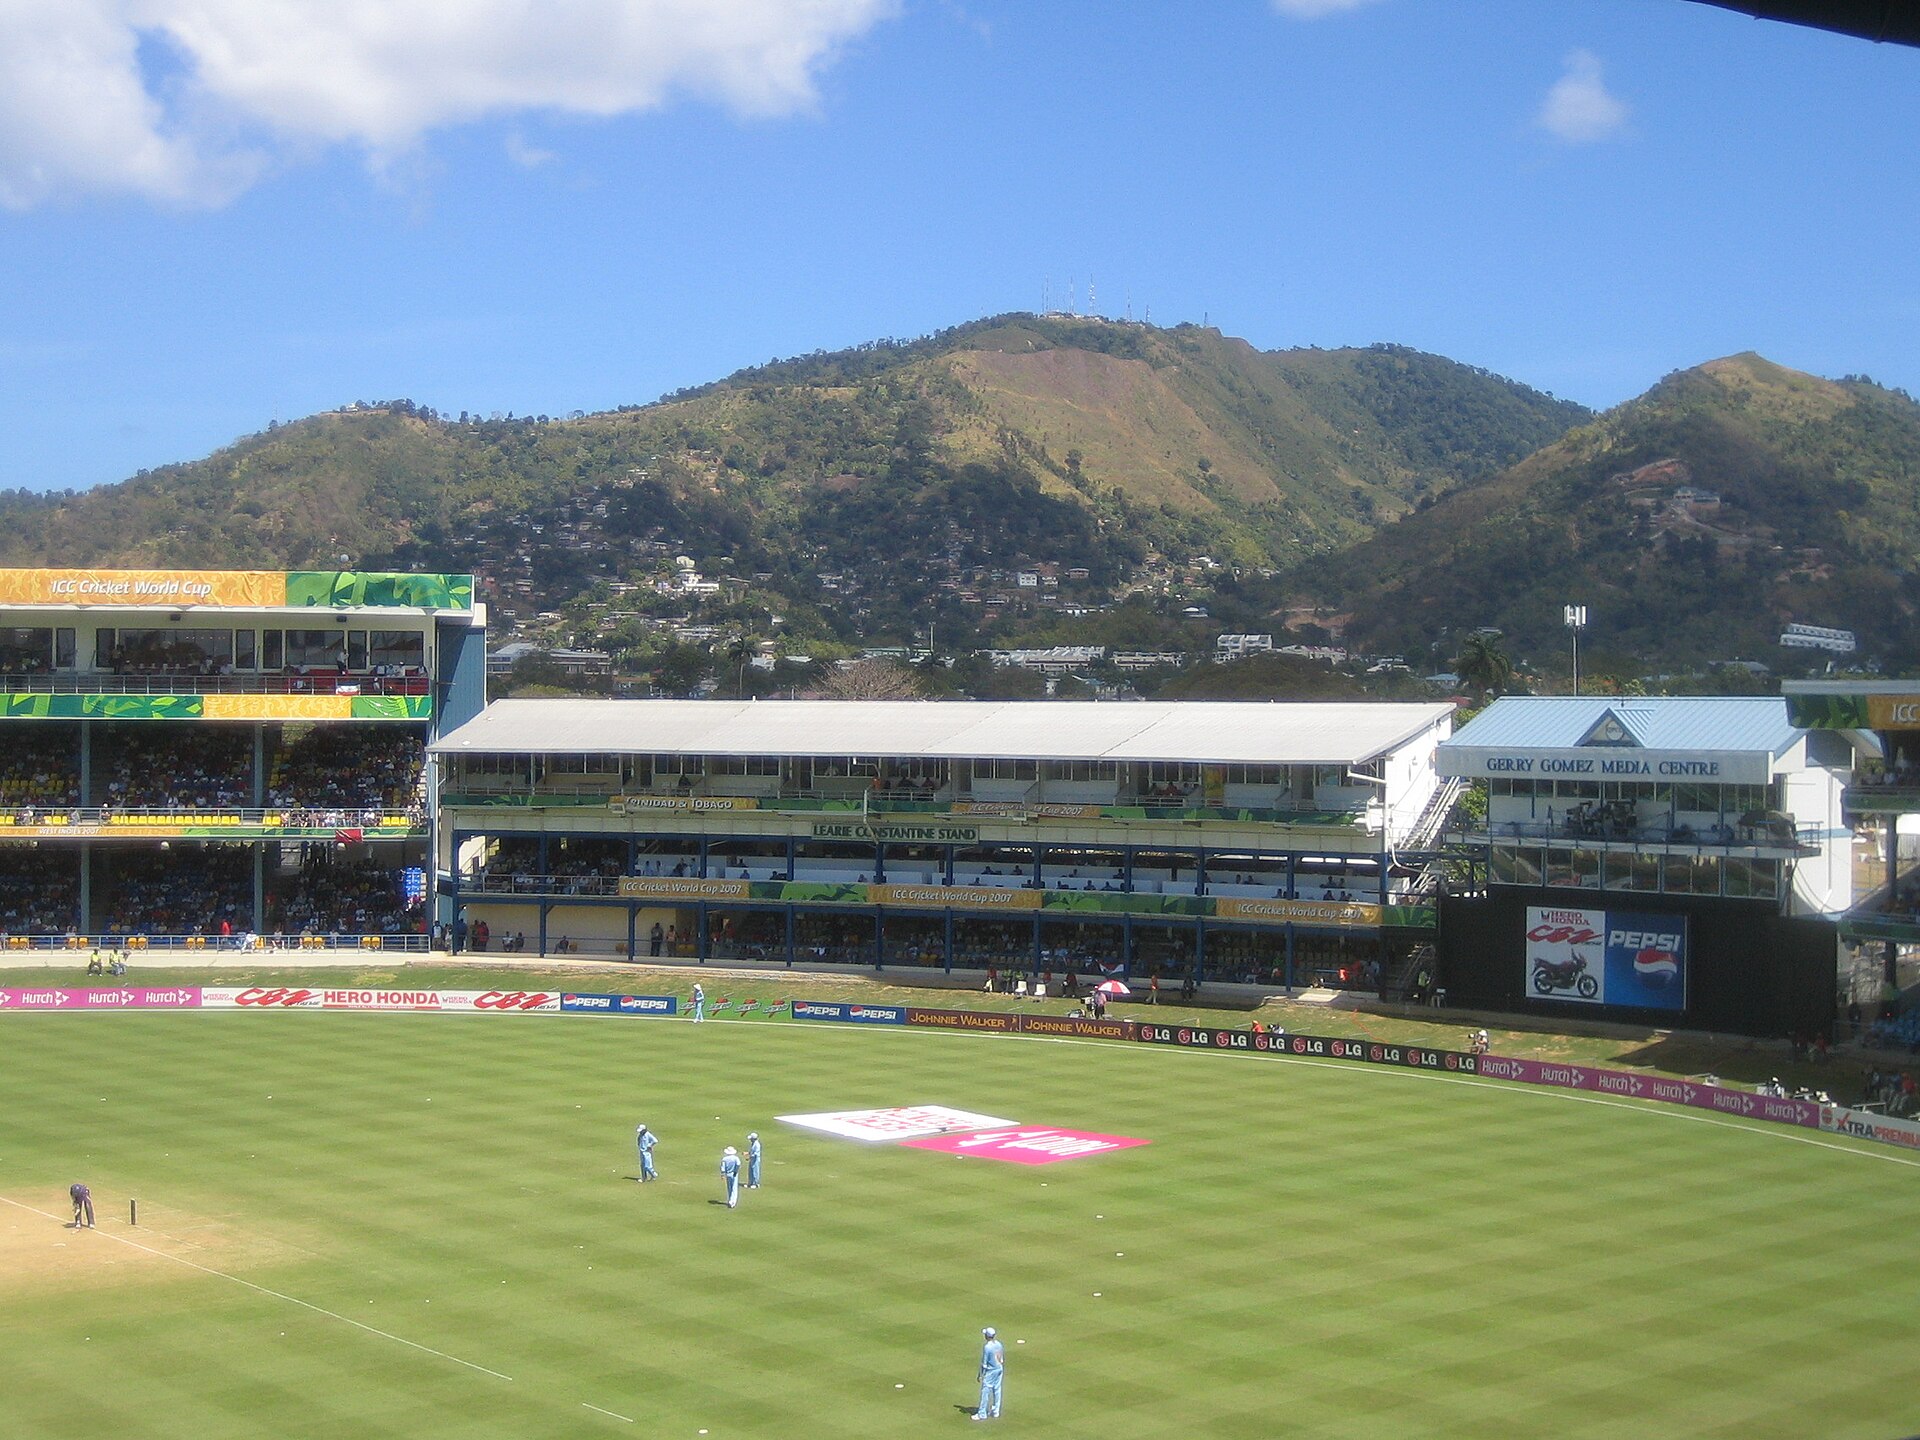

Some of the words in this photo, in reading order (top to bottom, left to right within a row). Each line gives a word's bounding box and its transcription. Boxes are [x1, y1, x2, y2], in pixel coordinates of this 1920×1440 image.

[51, 580, 76, 593] ICC
[79, 580, 131, 594] Cricket
[135, 580, 180, 594] World
[182, 581, 212, 598] Cup
[1892, 704, 1919, 722] ICC
[1487, 758, 1534, 772] GERRY
[1540, 759, 1594, 773] GOMEZ
[1602, 760, 1650, 774] MEDIA
[1659, 761, 1719, 776] CENTRE
[626, 797, 676, 809] TRINIDAD
[691, 798, 733, 810] TOBAGO
[1043, 806, 1060, 816] Cup
[1061, 806, 1083, 816] 2007
[813, 825, 852, 837] LEARIE
[855, 826, 935, 840] CONSTANTINE
[938, 828, 977, 840] STAND
[623, 882, 638, 891] ICC
[640, 882, 669, 893] Cricket
[672, 883, 698, 893] World
[701, 884, 718, 895] Cup
[720, 884, 742, 894] 2007
[892, 889, 907, 899] ICC
[908, 890, 939, 900] Cricket
[941, 891, 968, 901] World
[970, 892, 988, 904] Cup
[990, 893, 1013, 903] 2007
[1238, 904, 1254, 913] ICC
[1255, 904, 1286, 915] Cricket
[1289, 906, 1316, 917] World
[1318, 908, 1336, 920] Cup
[1551, 918, 1590, 926] HONDA
[1608, 930, 1681, 952] PEPSI
[324, 991, 372, 1003] HERO
[376, 992, 440, 1005] HONDA
[575, 997, 610, 1007] PEPSI
[632, 999, 668, 1009] PEPSI
[806, 1006, 841, 1016] PEPSI
[862, 1009, 896, 1019] PEPSI
[910, 1012, 958, 1025] JOHNNIE
[960, 1015, 1006, 1028] WALKER
[1025, 1019, 1073, 1033] JOHNNIE
[1075, 1022, 1122, 1036] WALKER
[1155, 1028, 1171, 1040] LG
[1192, 1031, 1208, 1044] LG
[1230, 1034, 1247, 1047] LG
[1269, 1037, 1285, 1050] LG
[1307, 1040, 1323, 1053] LG
[1345, 1044, 1362, 1056] LG
[1384, 1048, 1400, 1061] LG
[1421, 1052, 1437, 1065] LG
[1459, 1057, 1475, 1070] LG
